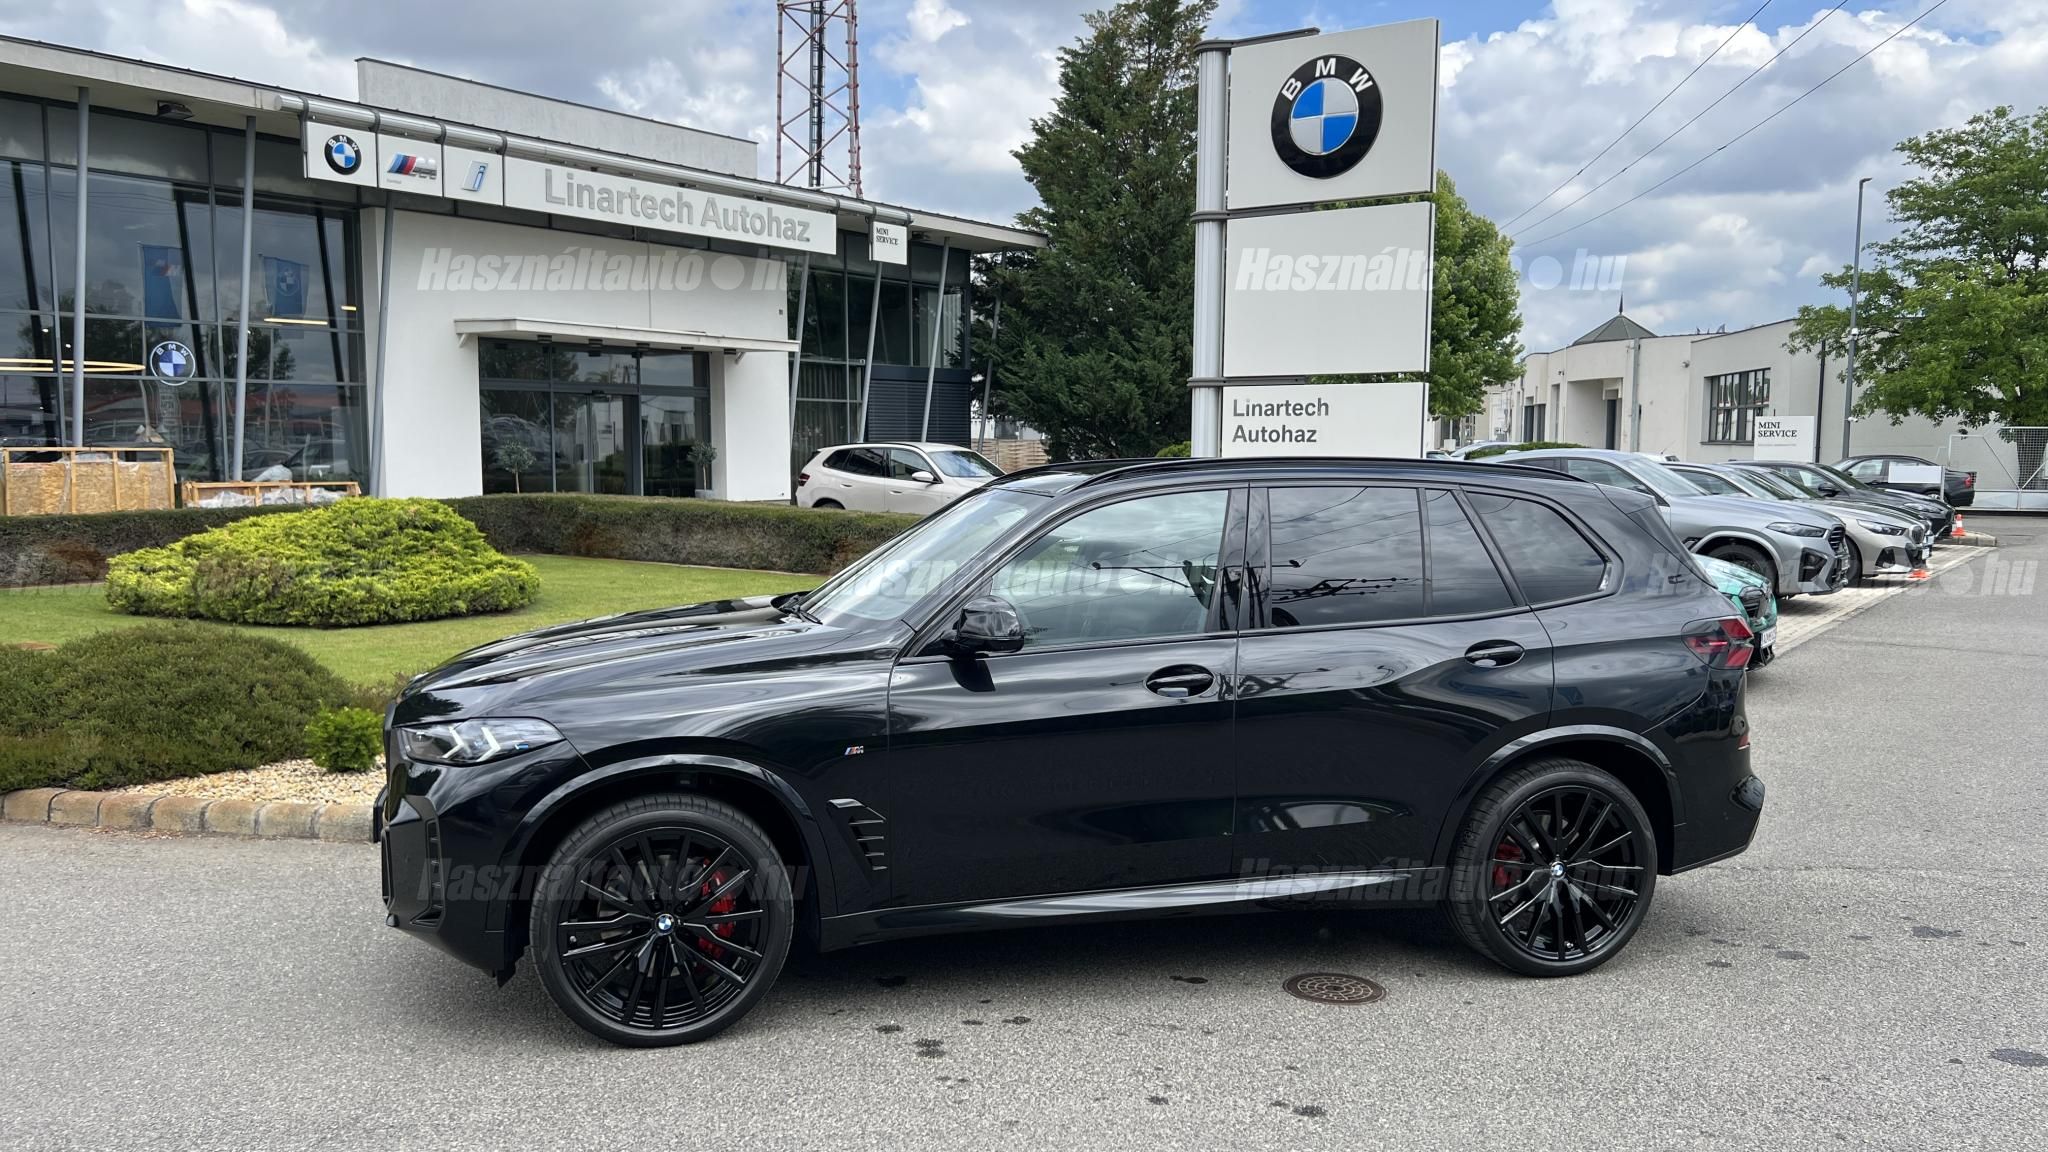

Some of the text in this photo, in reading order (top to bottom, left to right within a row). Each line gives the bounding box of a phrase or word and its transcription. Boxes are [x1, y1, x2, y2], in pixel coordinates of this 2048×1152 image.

[1281, 56, 1374, 101] BMW
[545, 168, 811, 242] Linartech Autohaz
[1233, 397, 1329, 418] Linartech
[1232, 425, 1318, 443] Autohaz
[1758, 421, 1781, 429] MINI
[1758, 430, 1798, 438] SERVICE
